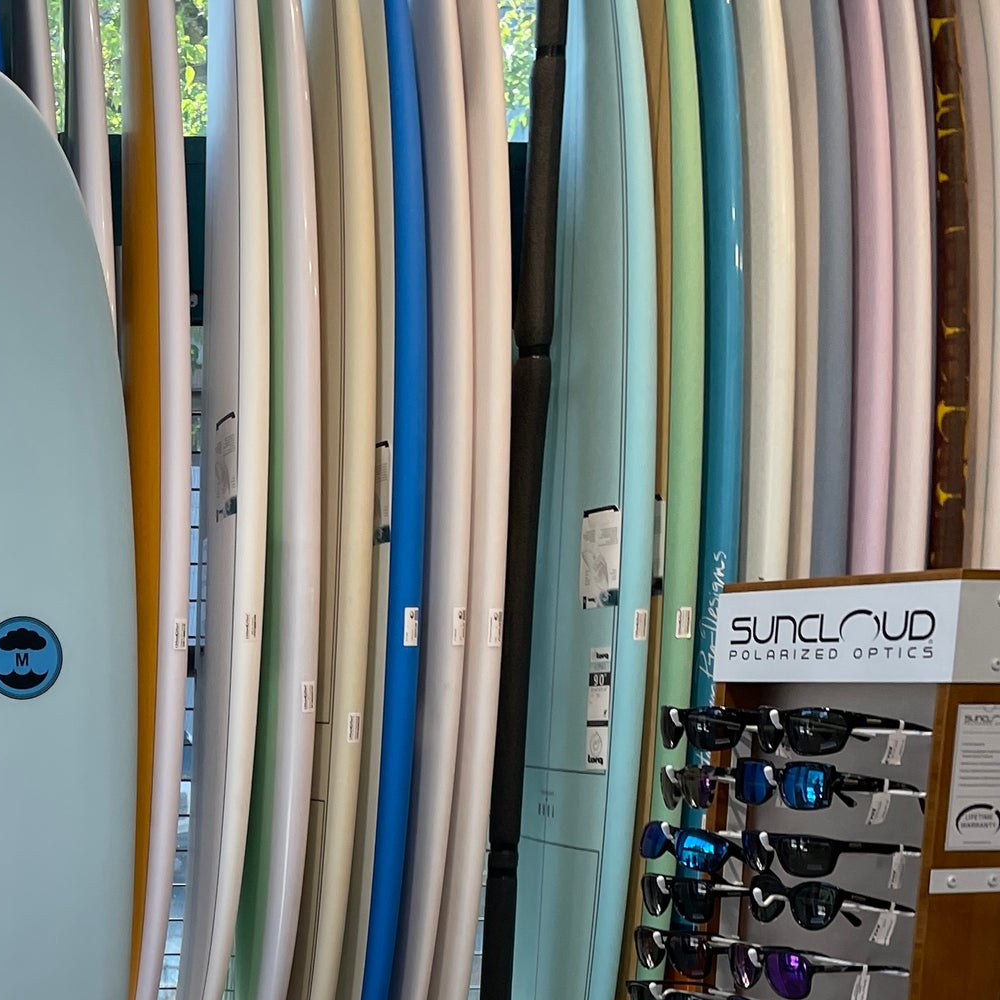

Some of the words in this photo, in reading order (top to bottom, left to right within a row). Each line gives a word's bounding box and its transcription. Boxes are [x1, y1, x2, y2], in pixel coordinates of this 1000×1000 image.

[730, 608, 936, 645] SUNCLOUD
[15, 652, 30, 667] M
[728, 648, 839, 661] POLARIZED
[853, 646, 934, 660] OPTICS
